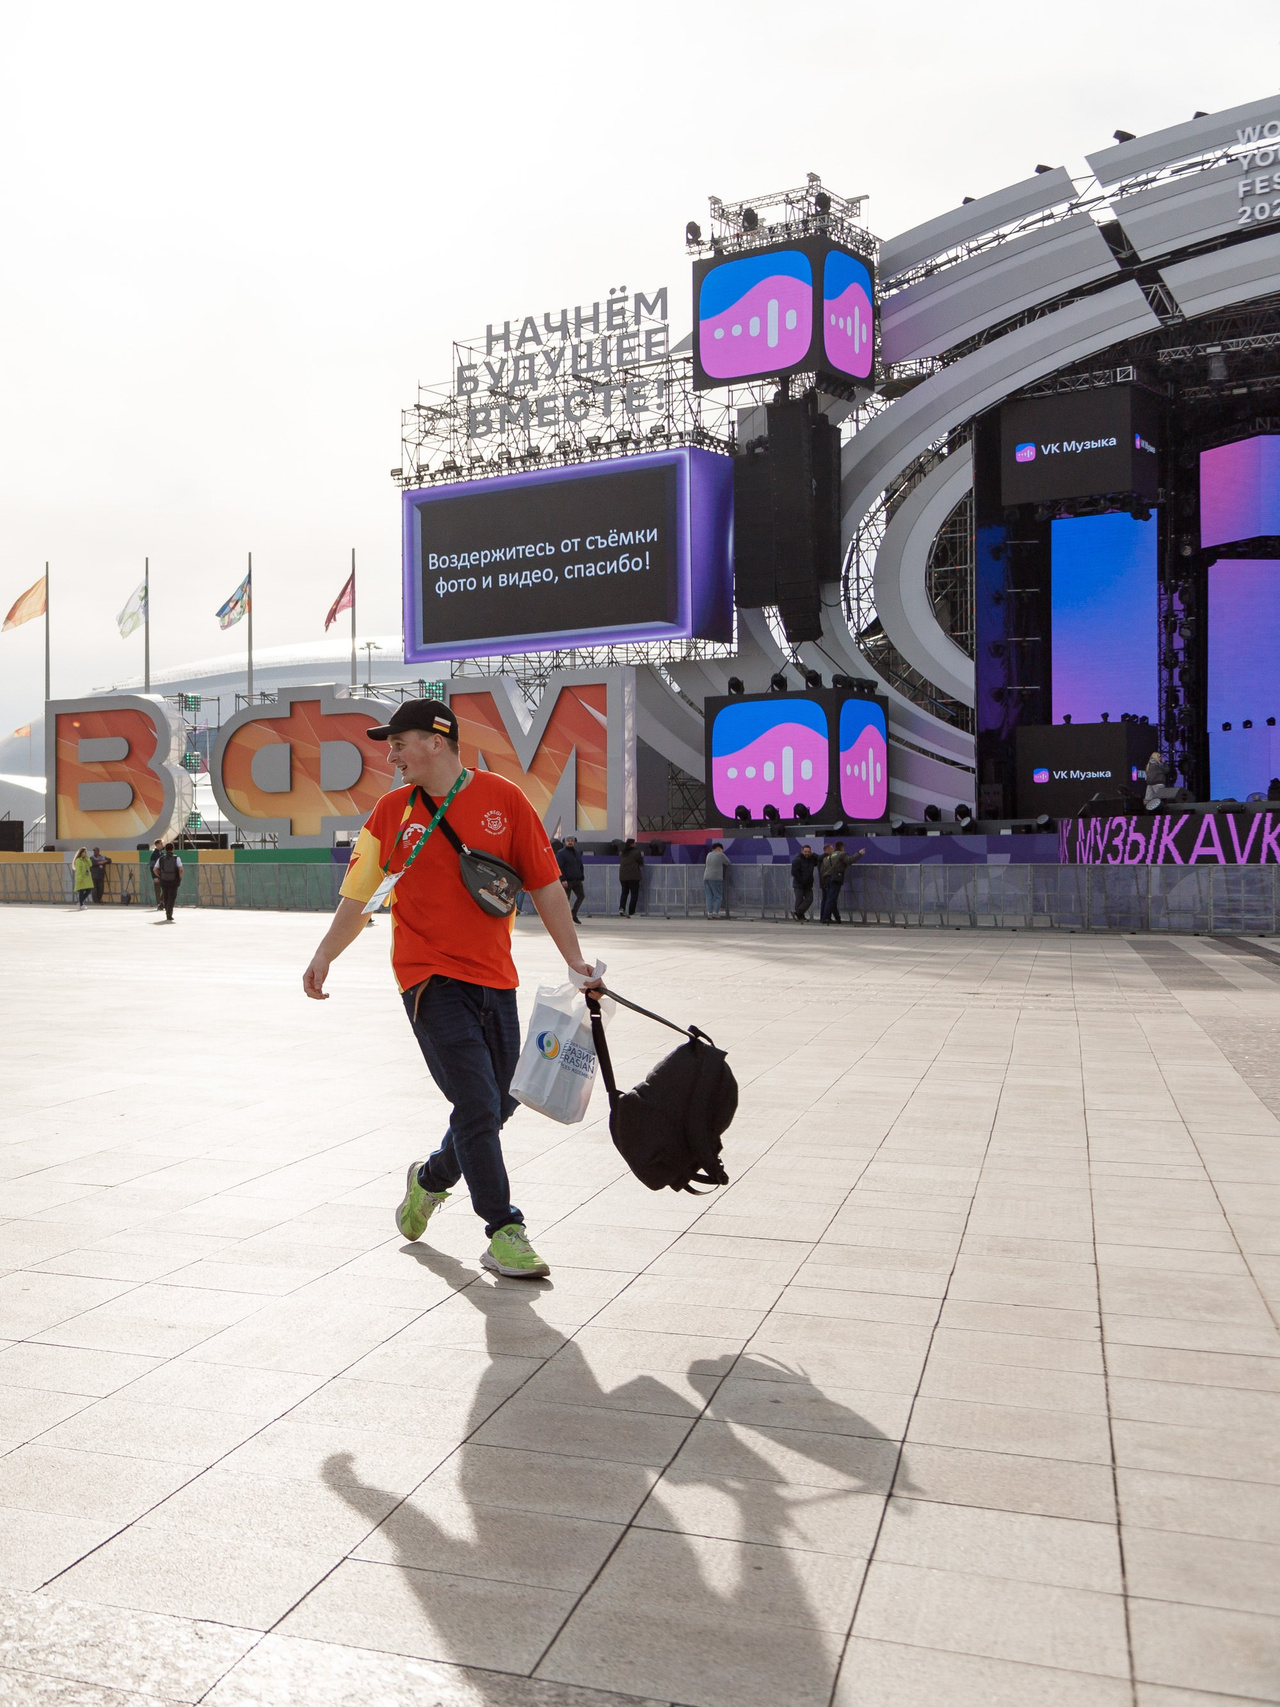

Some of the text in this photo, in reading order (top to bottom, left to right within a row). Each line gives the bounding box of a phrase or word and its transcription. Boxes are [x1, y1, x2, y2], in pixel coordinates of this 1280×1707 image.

[1237, 146, 1280, 170] YO
[486, 285, 668, 356] НАЧНЁМ
[457, 326, 669, 396] БУДУЩЕЕ
[470, 378, 665, 439] ВМЕСТЕ!
[1041, 437, 1117, 455] VK Музыка
[428, 528, 658, 570] Воздержитесь от съёмки
[435, 551, 651, 597] фото и видео, спасибо!
[1053, 770, 1112, 781] VK Музыка
